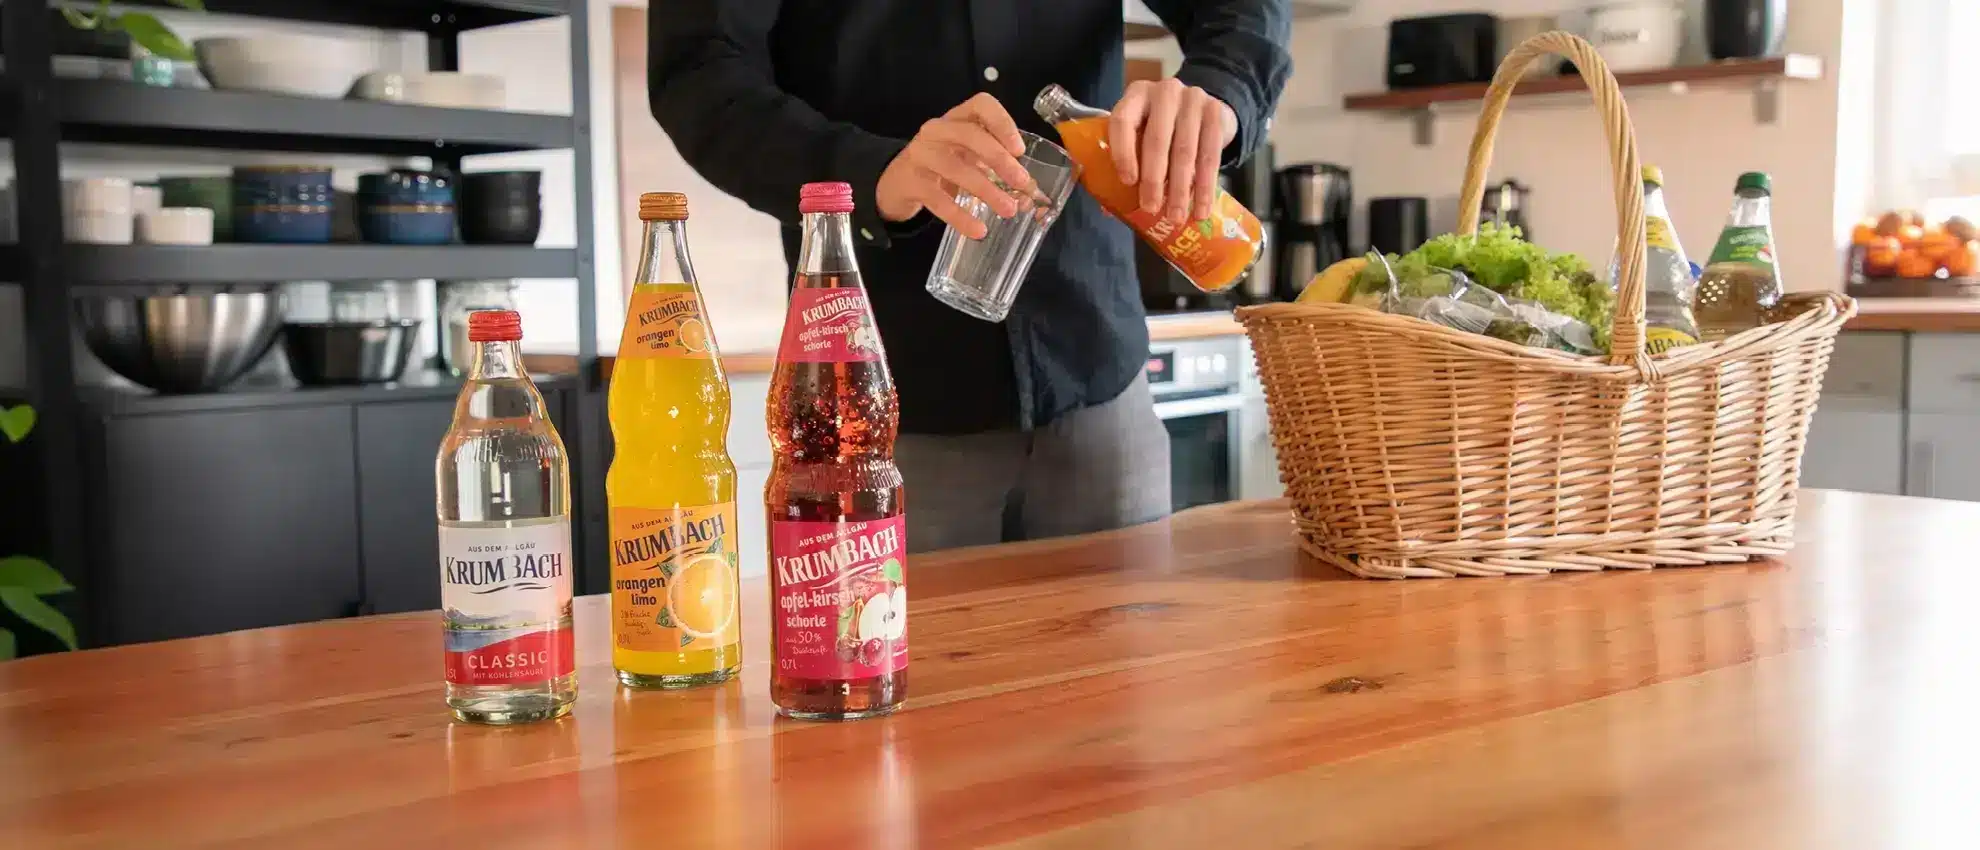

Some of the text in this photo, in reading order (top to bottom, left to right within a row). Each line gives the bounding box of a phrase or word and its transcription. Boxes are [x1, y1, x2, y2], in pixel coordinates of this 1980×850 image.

[1167, 226, 1201, 258] ACE
[639, 299, 699, 326] KRUMBACH
[802, 295, 866, 325] KRUMBACH
[637, 328, 675, 343] orangen
[799, 323, 850, 343] apfel-kirsch
[651, 341, 669, 350] limo
[803, 340, 832, 352] schorle
[631, 521, 645, 530] AUS
[645, 518, 662, 527] DEM
[614, 513, 726, 566] KRUMBACH
[799, 521, 868, 548] AUS DEM ALLGÄU
[468, 545, 483, 553] AUS
[484, 544, 502, 553] DEM
[776, 524, 899, 587] KRUMBACH
[445, 552, 562, 586] KRUMBACH
[616, 576, 666, 594] orangen
[631, 593, 657, 606] limo
[781, 588, 856, 614] apfel-kirsch
[786, 613, 827, 628] schorle
[798, 630, 822, 644] 50%
[468, 650, 548, 669] CLASSIC
[781, 658, 797, 670] 0,7l
